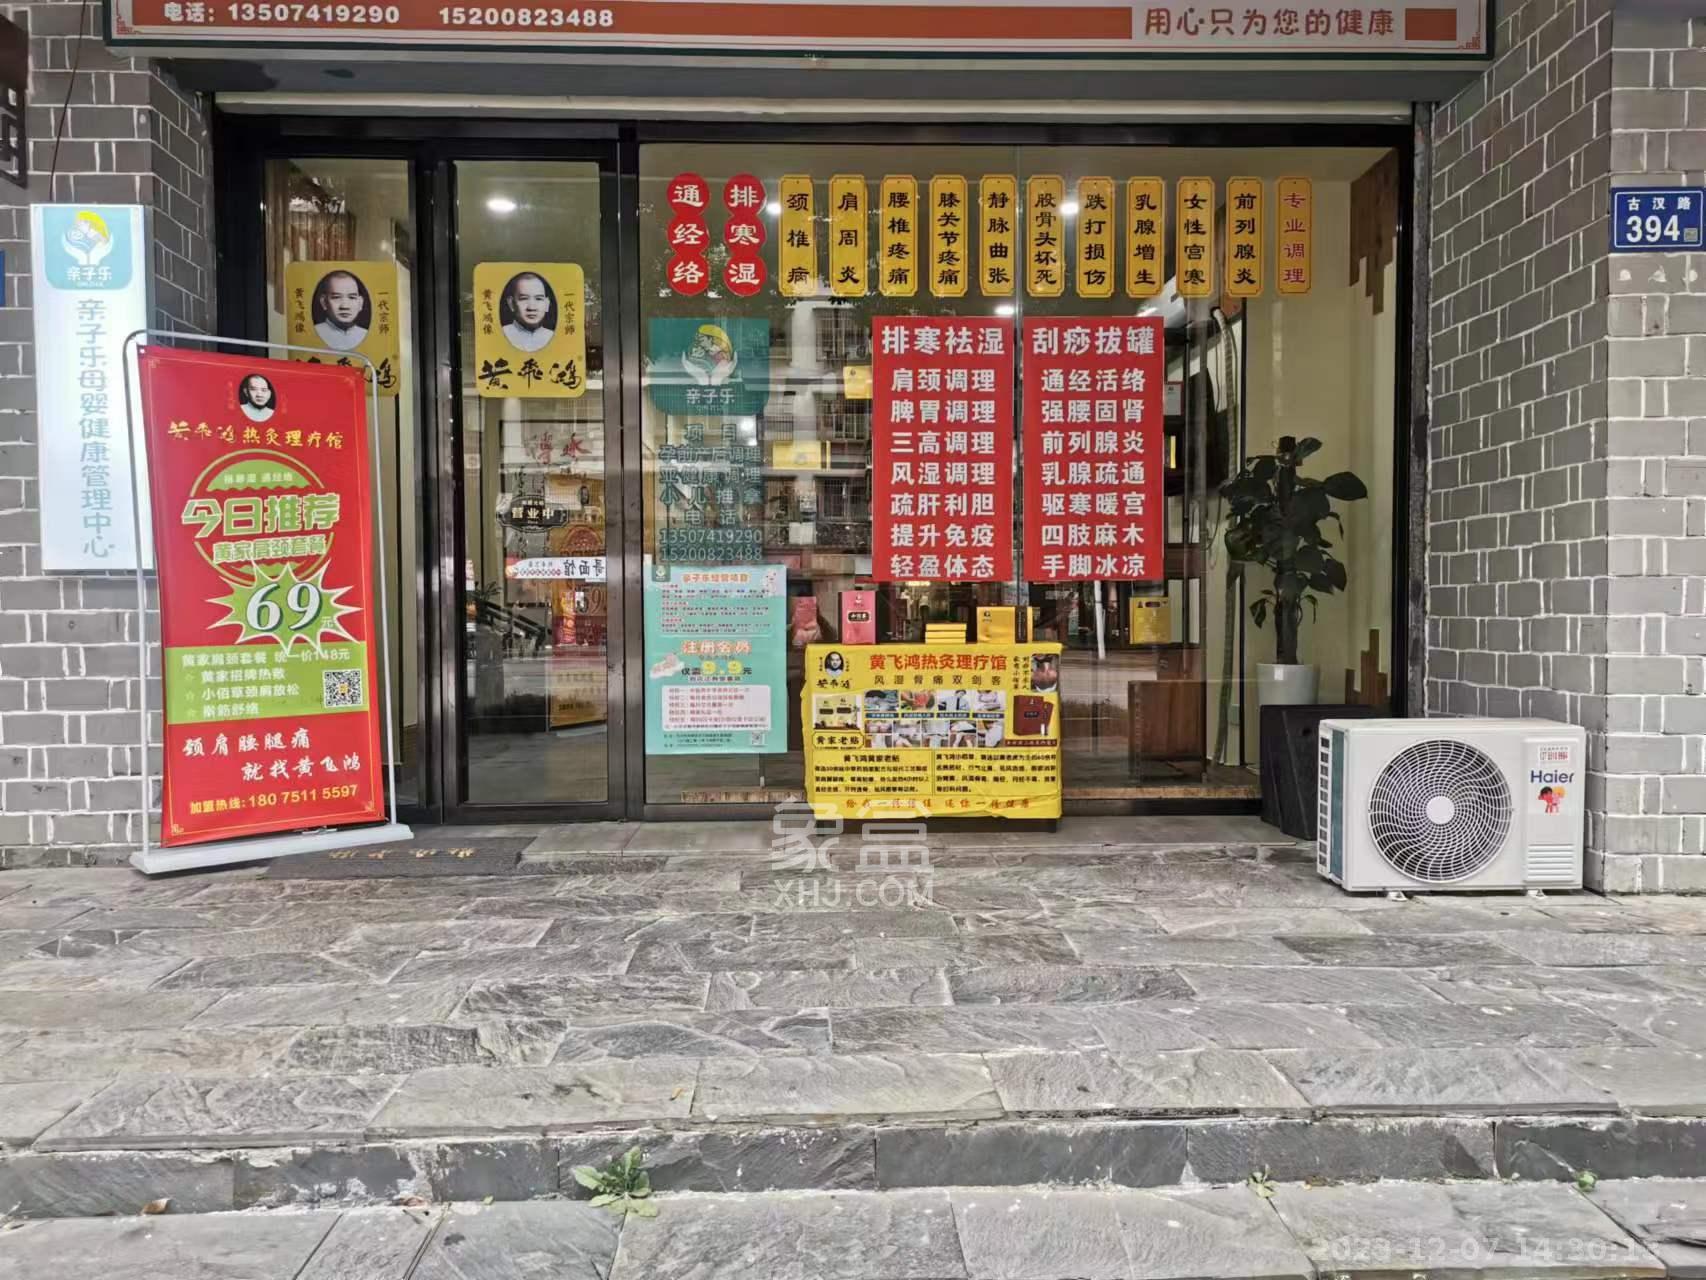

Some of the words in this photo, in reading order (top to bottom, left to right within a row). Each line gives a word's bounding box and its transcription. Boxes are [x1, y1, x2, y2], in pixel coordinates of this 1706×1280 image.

[229, 4, 400, 23] 13507419290
[439, 7, 614, 27] 15200823488
[1145, 8, 1394, 36] 用心只为您的健康
[1627, 197, 1691, 210] 古汉路
[672, 184, 704, 284] 通经络
[728, 184, 760, 284] 排寒湿
[786, 193, 810, 284] 颈椎病
[837, 193, 859, 284] 肩周炎
[887, 192, 910, 284] 腰椎疼痛
[937, 191, 960, 284] 膝关节疼痛
[987, 191, 1010, 284] 静脉曲张
[1034, 193, 1057, 284] 股骨头坏死
[1084, 194, 1107, 285] 跌打损伤
[1134, 194, 1157, 285] 乳腺增生
[1184, 194, 1206, 285] 女性宫寒
[1234, 193, 1256, 284] 前列腺炎
[1283, 193, 1306, 284] 专业调理
[1626, 215, 1680, 242] 394
[66, 265, 113, 281] 亲子乐
[564, 293, 576, 335] 一代宗师
[882, 326, 1005, 355] 排寒祛湿
[1032, 326, 1155, 355] 刮痧拔罐
[891, 368, 996, 392] 肩颈调理
[1041, 368, 1146, 392] 通经活络
[686, 388, 735, 404] 亲子乐
[891, 399, 996, 424] 脾胃调理
[1041, 399, 1145, 424] 强腰固肾
[76, 299, 115, 558] 亲子乐母婴健康管理中心
[659, 445, 760, 463] 孕前产后调理
[890, 430, 995, 455] 三高调理
[1041, 431, 1145, 455] 前列腺炎
[891, 462, 995, 486] 风湿调理
[1041, 462, 1145, 486] 乳腺疏通
[181, 493, 341, 538] 今日推荐
[512, 507, 554, 519] 营业中
[890, 492, 995, 517] 疏肝利胆
[1042, 492, 1145, 517] 驱寒暖宫
[660, 529, 762, 544] 13507419290
[890, 524, 995, 548] 提升免疫
[1041, 523, 1145, 547] 四肢麻木
[213, 534, 328, 564] 黄家肩颈套餐
[660, 548, 762, 561] 15200823488
[890, 554, 994, 578] 轻盈体态
[1041, 553, 1145, 578] 手脚冰凉
[246, 583, 322, 631] 69
[869, 654, 1008, 671] 黄飞鸿热灸理疗馆
[183, 728, 310, 757] 颈肩腰腿痛
[241, 752, 360, 781] 就找黄飞鸿
[1531, 770, 1575, 783] Haier
[249, 793, 277, 808] 180
[283, 789, 317, 804] 7511
[322, 785, 358, 799] 5597
